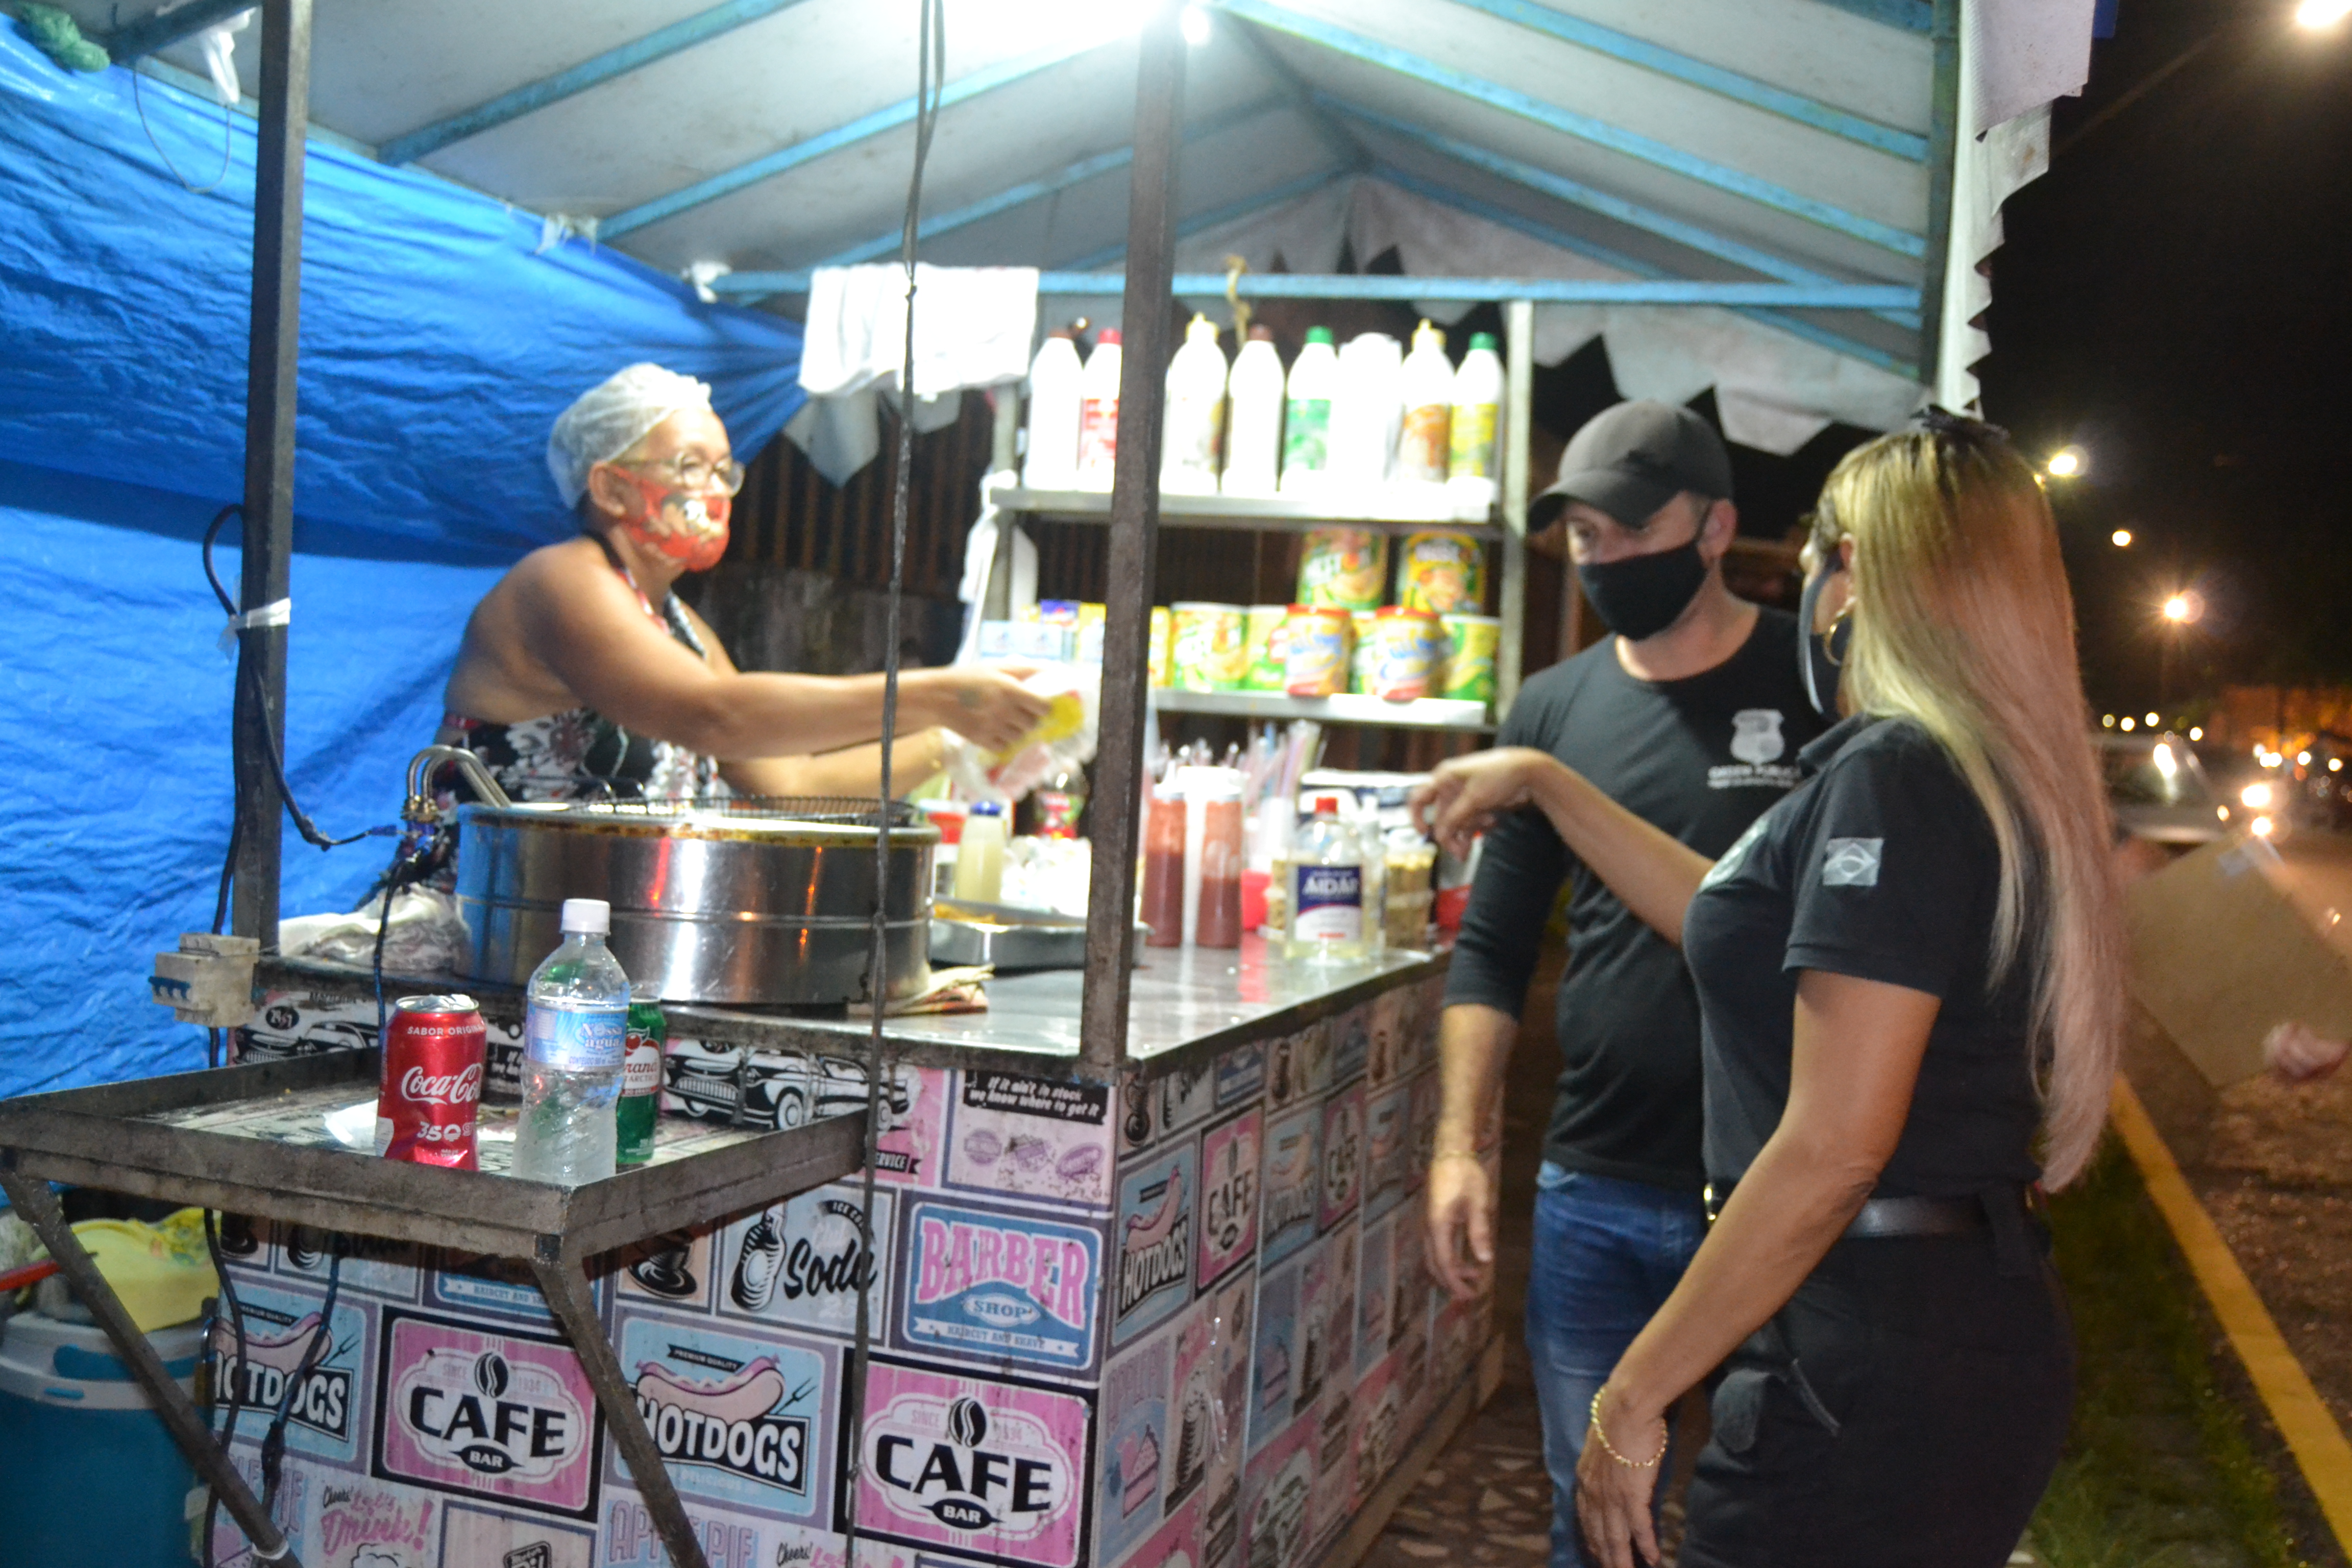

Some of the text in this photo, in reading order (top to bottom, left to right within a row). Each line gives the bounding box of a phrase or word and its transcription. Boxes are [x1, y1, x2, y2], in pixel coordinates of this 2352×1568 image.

[407, 1026, 444, 1035] SABOR
[875, 1152, 906, 1170] ERVICE
[917, 1218, 1089, 1330] BARBER
[974, 1301, 1027, 1317] SHOP
[410, 1386, 566, 1457] CAFE
[470, 1451, 504, 1467] BAR
[876, 1434, 1052, 1512] CAFE
[944, 1505, 982, 1524] BAR
